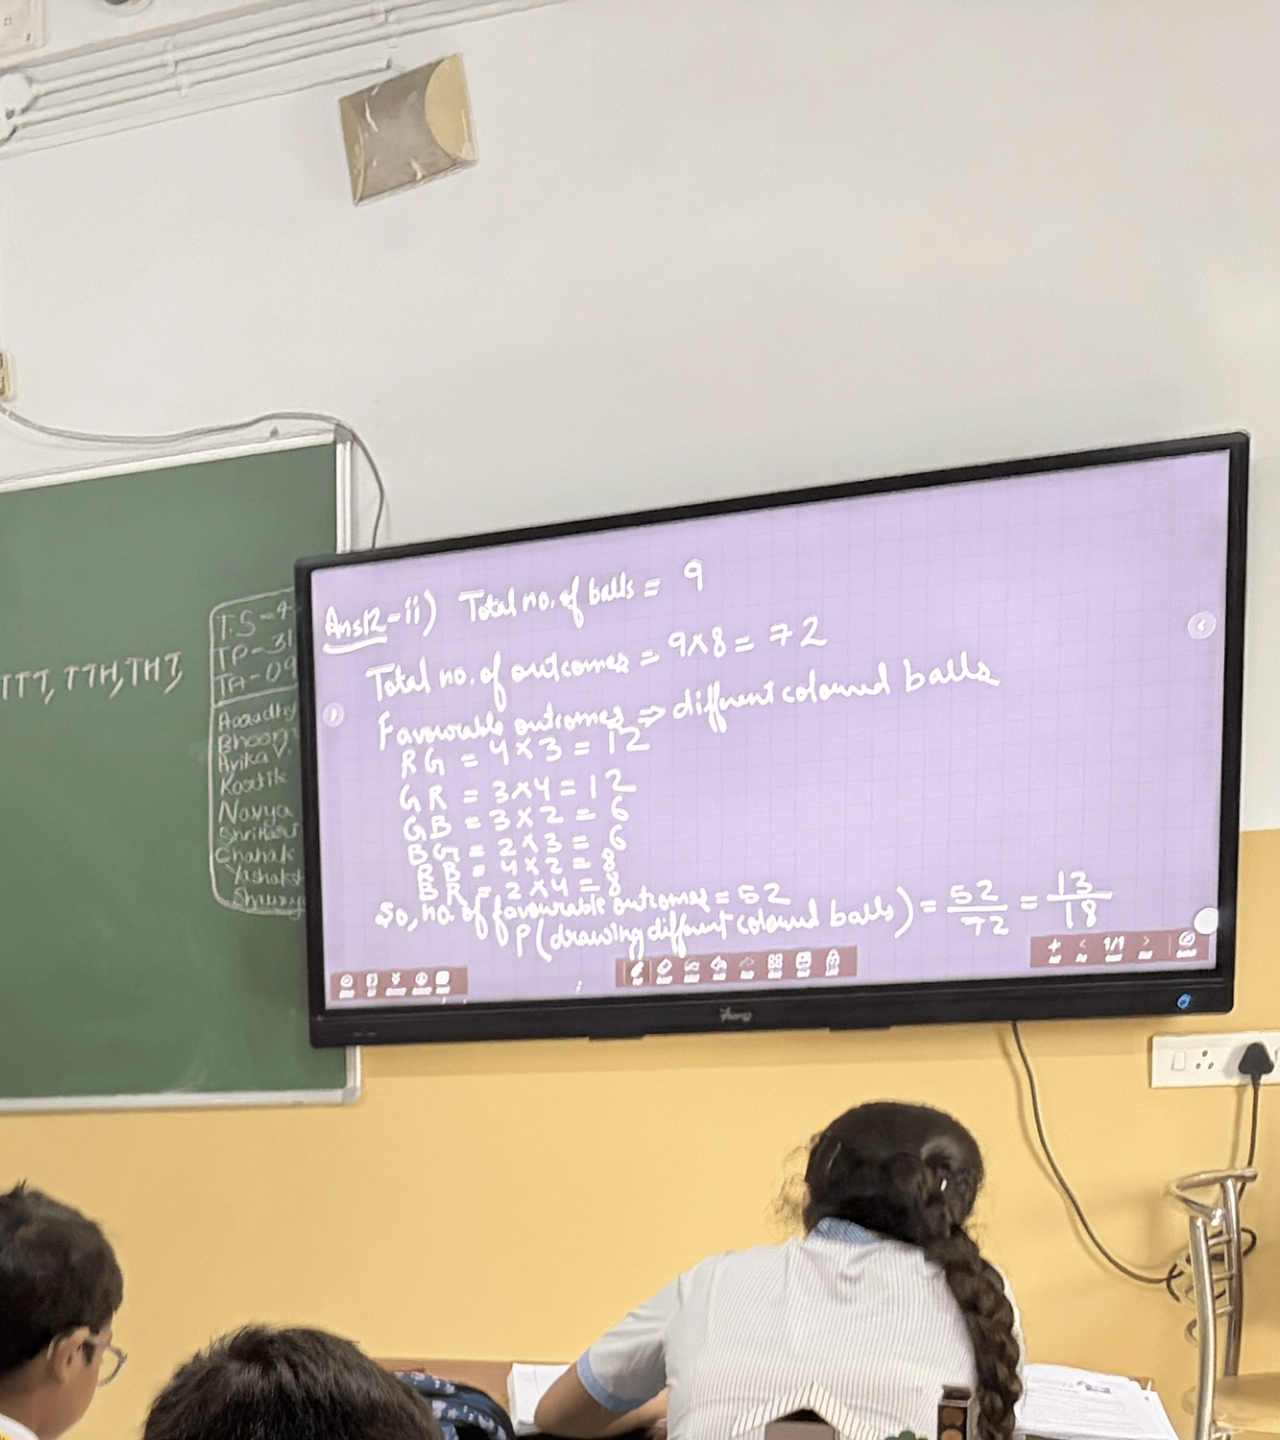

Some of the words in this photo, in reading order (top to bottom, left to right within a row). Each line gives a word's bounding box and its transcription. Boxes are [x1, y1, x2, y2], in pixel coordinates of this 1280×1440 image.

[458, 587, 517, 621] Total
[559, 575, 585, 629] of
[588, 572, 635, 604] balls
[683, 559, 704, 591] 9
[365, 656, 432, 701] Total
[480, 650, 507, 712] of
[769, 615, 827, 647] 72
[903, 650, 1001, 692] balls
[608, 726, 651, 754] 12
[590, 768, 637, 799] 12
[610, 795, 630, 822] 6
[608, 824, 627, 851] 6
[948, 880, 1000, 905] 52
[1057, 870, 1094, 895] 13
[461, 888, 489, 940] of
[738, 882, 790, 906] 52
[959, 915, 1010, 937] 72
[1064, 899, 1098, 929] 18
